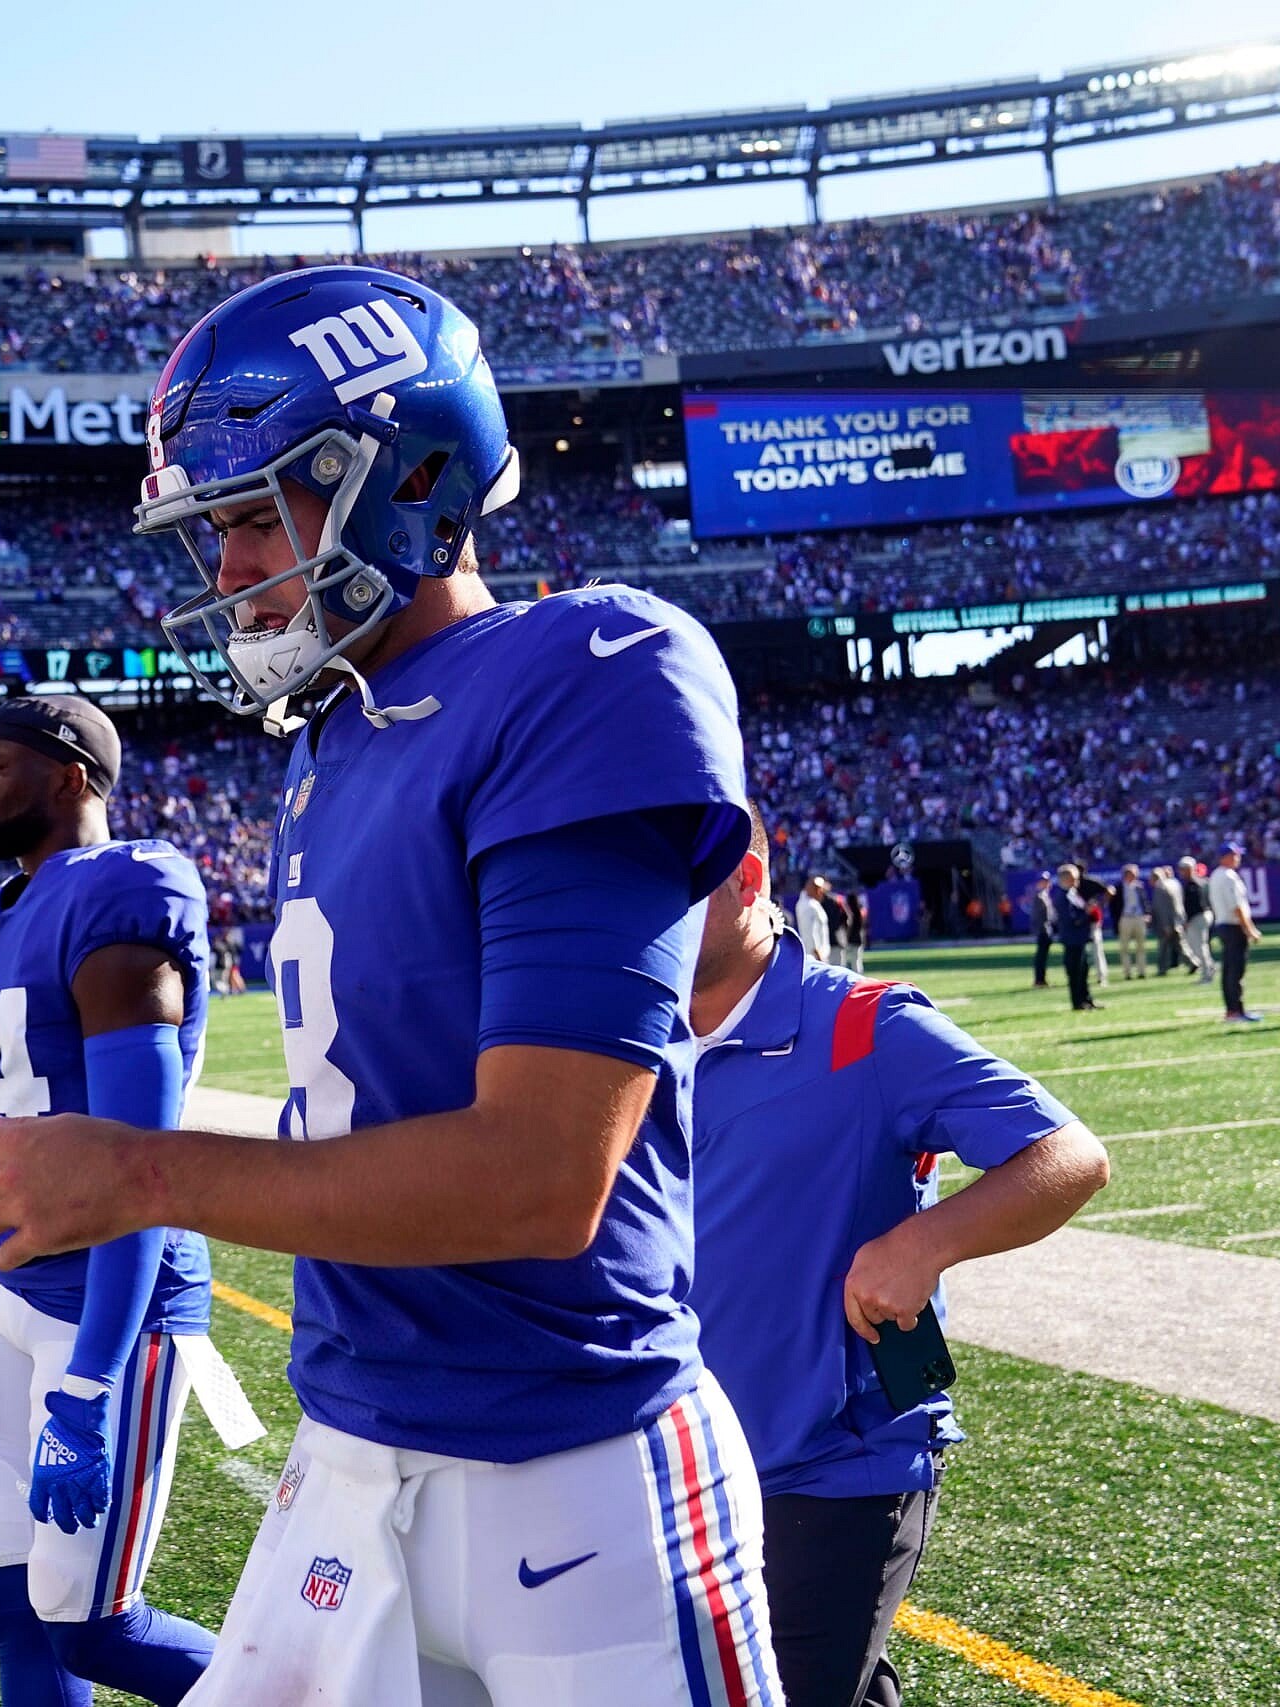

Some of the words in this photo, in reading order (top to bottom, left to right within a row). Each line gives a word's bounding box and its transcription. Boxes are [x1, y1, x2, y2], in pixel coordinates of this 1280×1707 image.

[882, 325, 1068, 377] verizon
[10, 386, 152, 447] Met
[720, 418, 828, 444] THANK
[832, 410, 900, 435] YOU
[907, 403, 971, 429] FOR
[733, 459, 868, 493] TODAY'S
[270, 897, 356, 1140] 8
[42, 1427, 78, 1462] adidas
[304, 1573, 340, 1607] NFL
